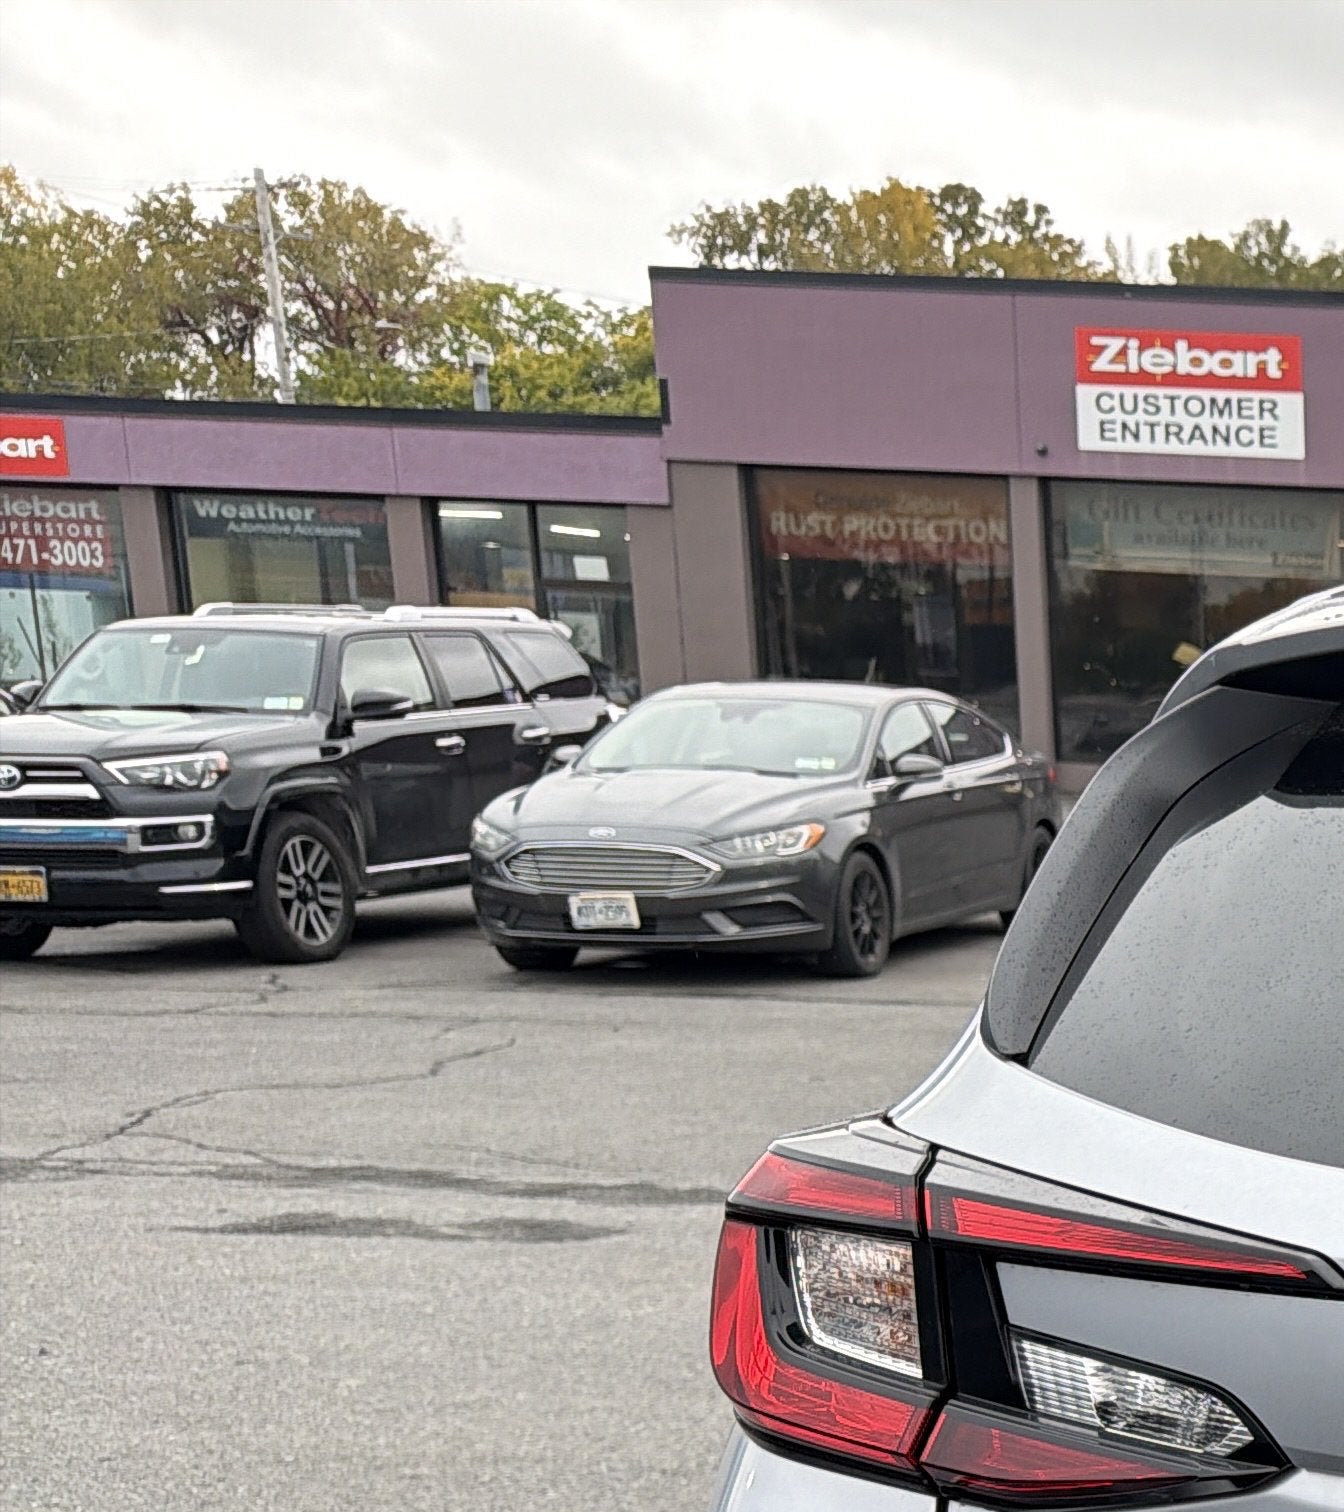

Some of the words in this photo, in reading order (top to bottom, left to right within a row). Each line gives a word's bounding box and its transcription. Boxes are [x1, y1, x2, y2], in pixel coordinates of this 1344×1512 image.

[1088, 334, 1284, 379] Ziebart
[1095, 390, 1280, 421] CUSTOMER
[0, 434, 56, 460] art
[1099, 418, 1279, 449] ENTRANCE
[0, 493, 103, 520] iebart
[770, 509, 837, 539] RUST
[842, 511, 1008, 545] PROTECTION
